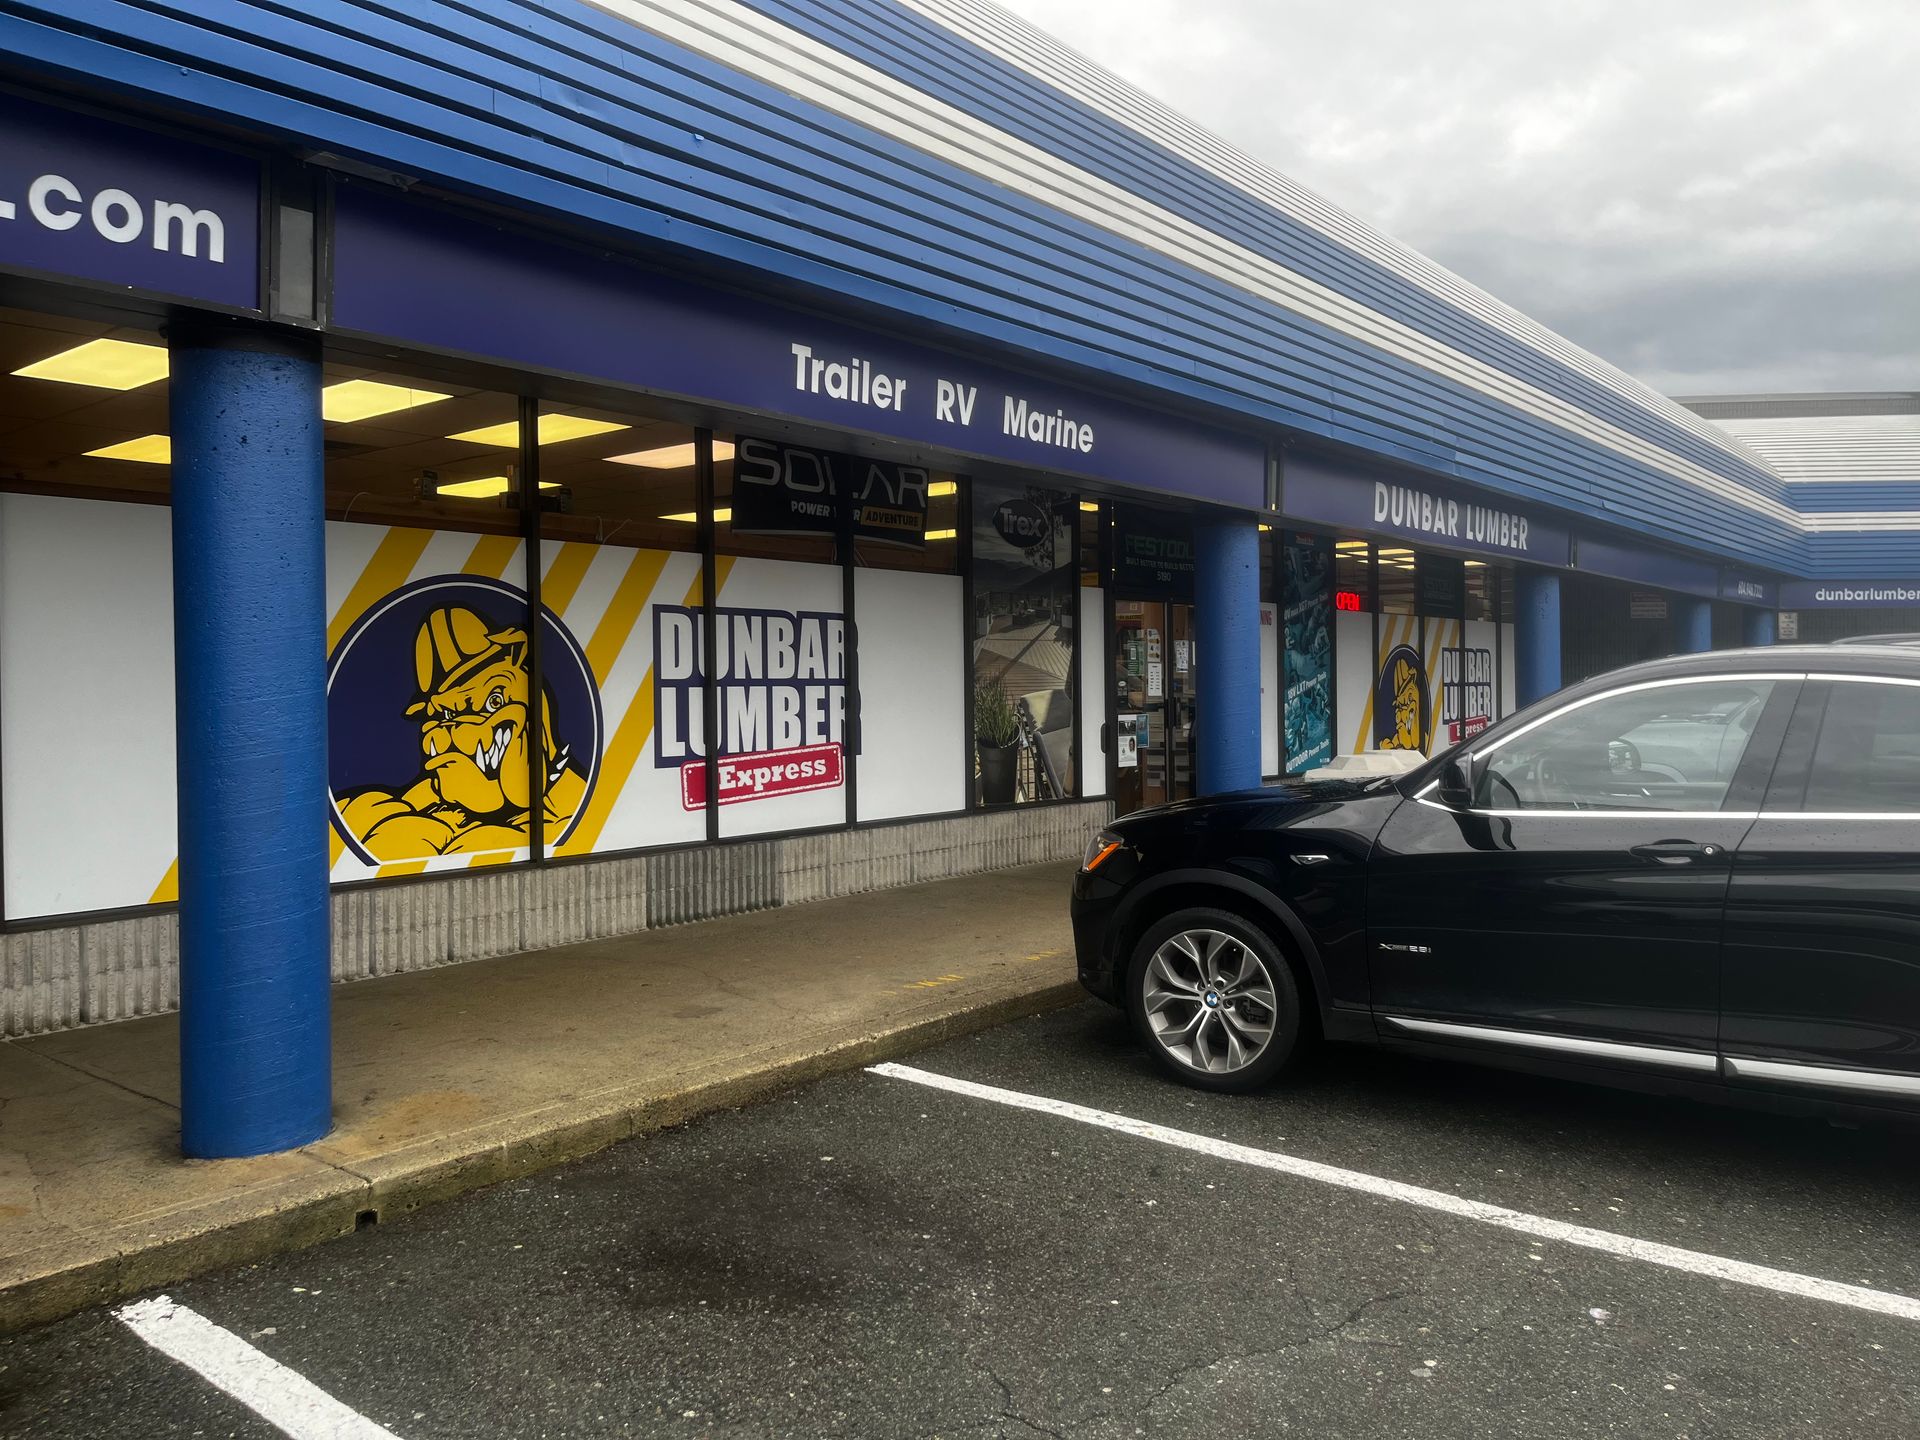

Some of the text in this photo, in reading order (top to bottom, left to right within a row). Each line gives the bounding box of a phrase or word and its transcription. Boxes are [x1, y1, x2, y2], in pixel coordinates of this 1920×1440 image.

[791, 342, 1094, 453] Trailer RV Marine
[791, 500, 831, 518] POWER
[865, 510, 919, 527] ADVENTURE
[999, 507, 1042, 538] Trex
[1374, 481, 1529, 550] DUNBAR LUMBER
[1336, 591, 1360, 611] OPEN
[660, 611, 846, 681] DUNBAR
[661, 685, 847, 758] LUMBER
[1456, 722, 1485, 739] Epress
[1286, 750, 1308, 773] OUTDOOR
[1308, 745, 1320, 759] Power
[718, 758, 828, 792] Express
